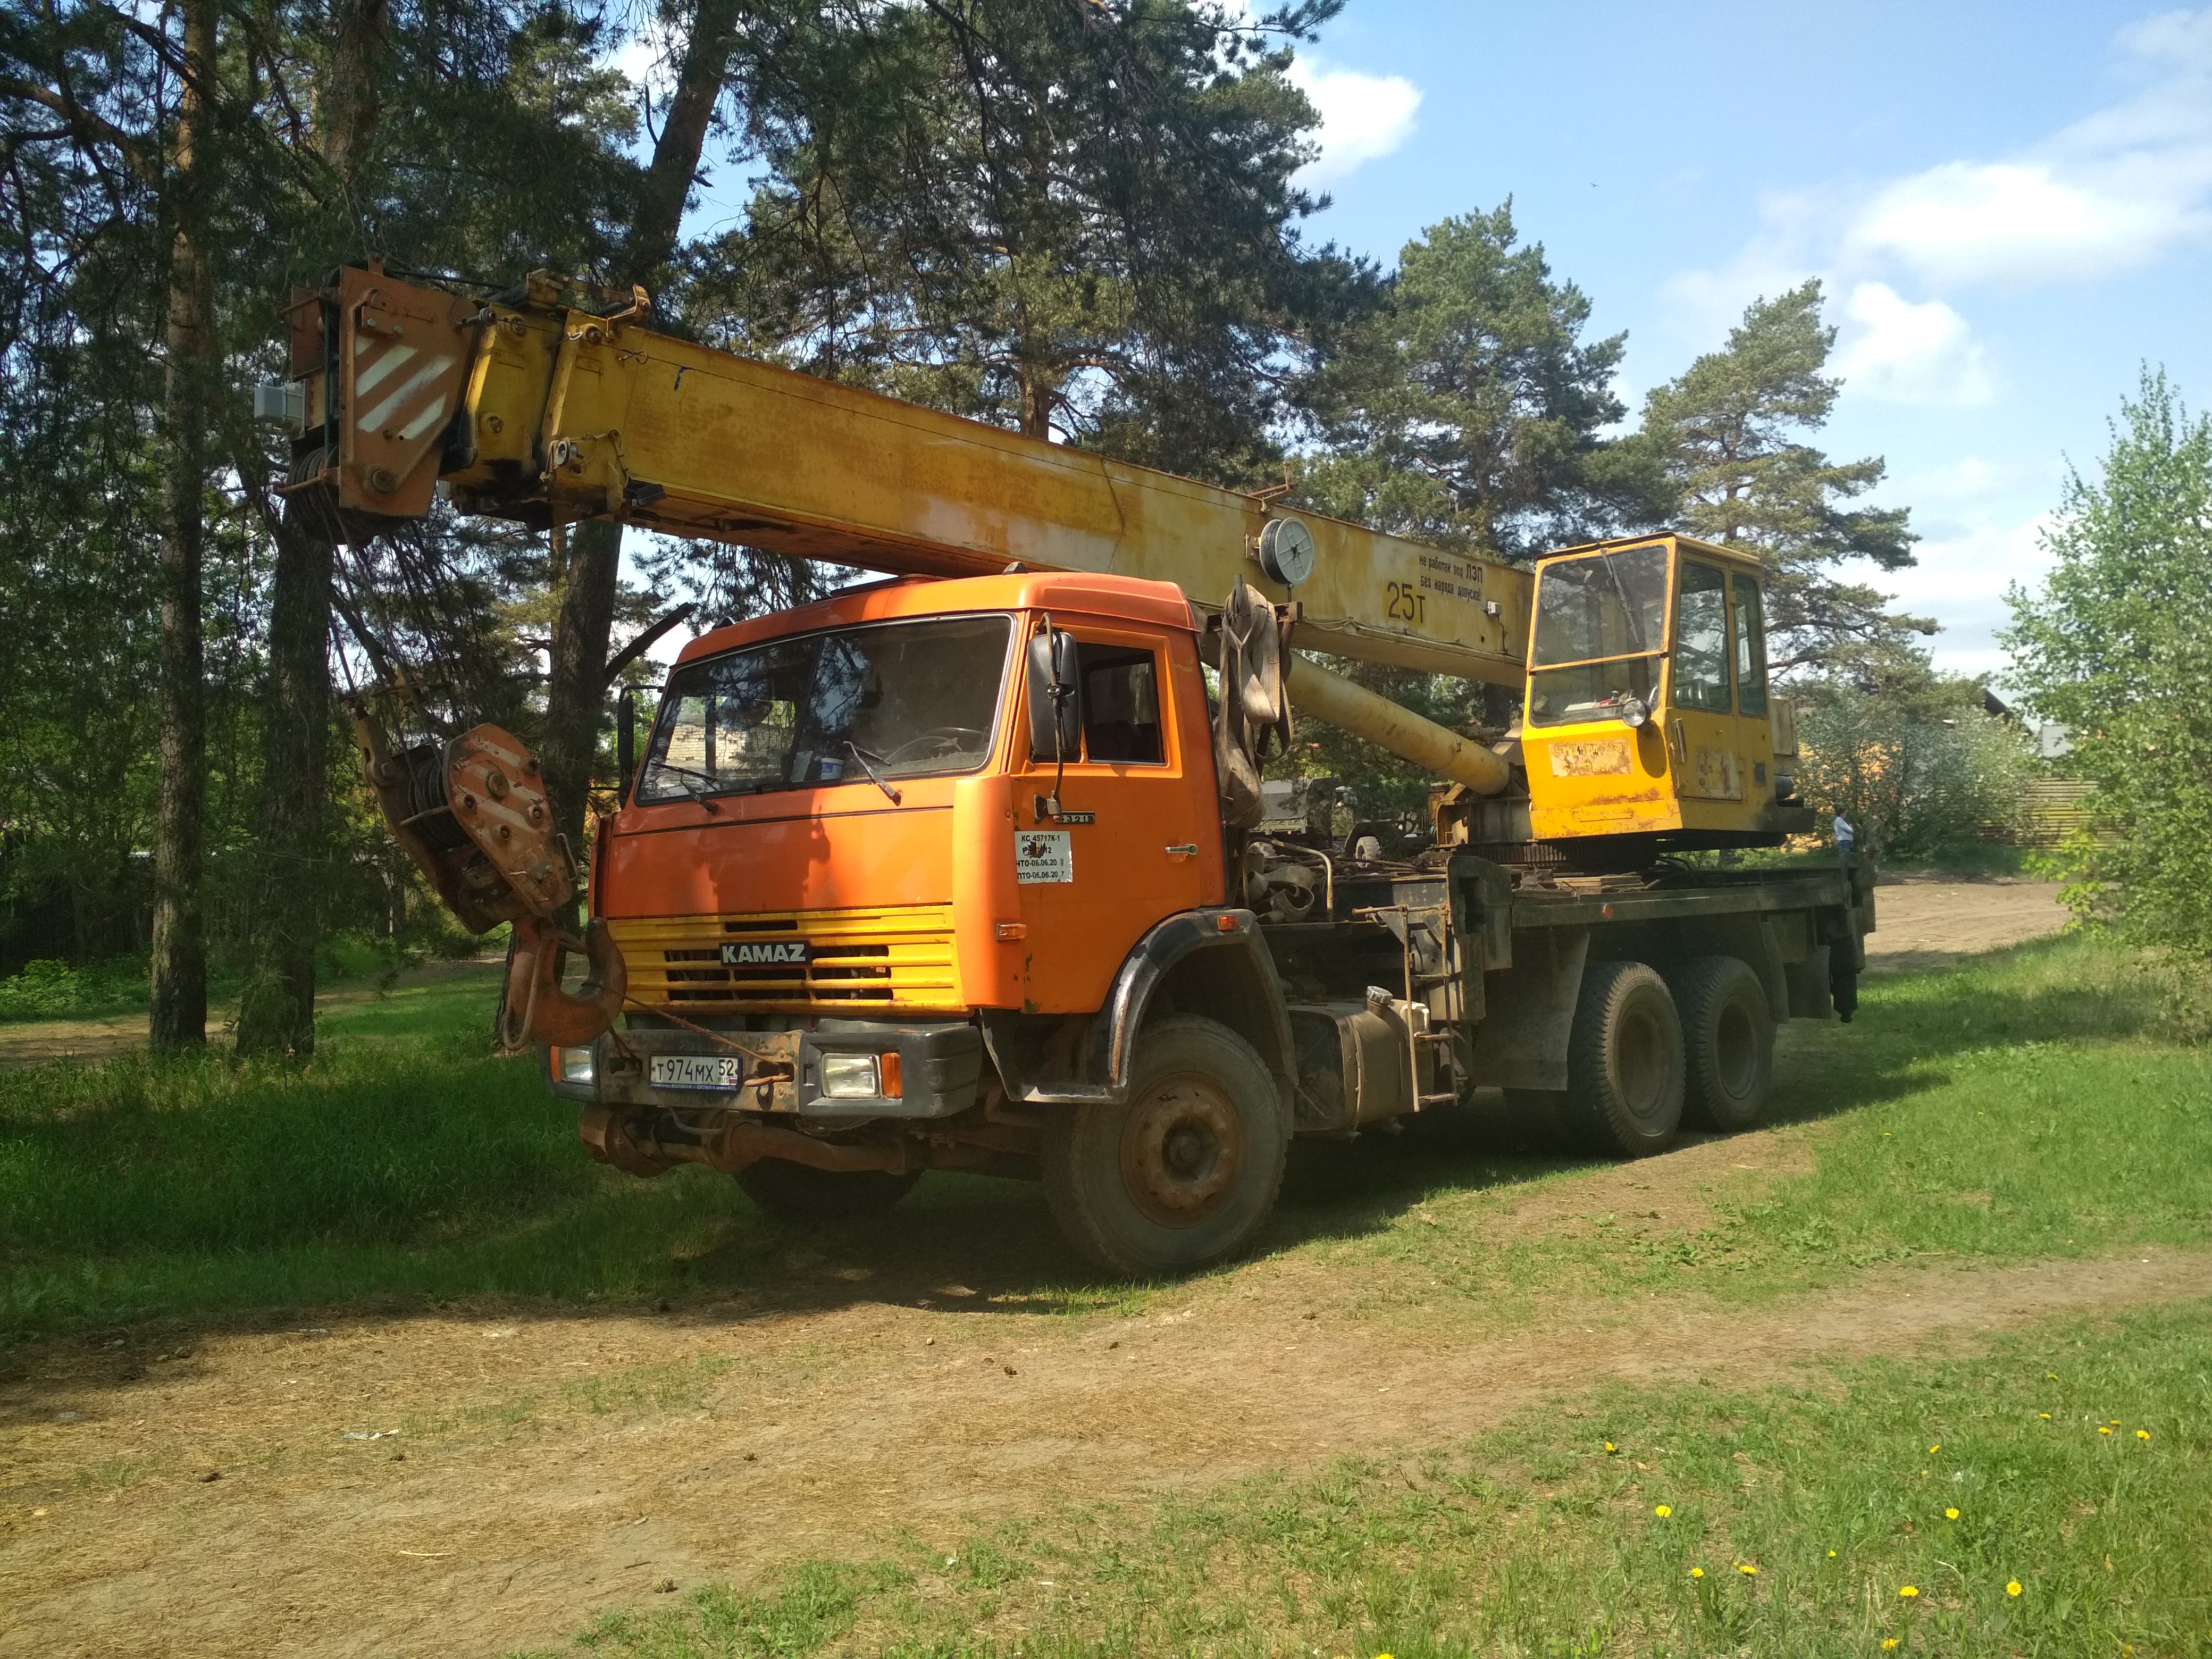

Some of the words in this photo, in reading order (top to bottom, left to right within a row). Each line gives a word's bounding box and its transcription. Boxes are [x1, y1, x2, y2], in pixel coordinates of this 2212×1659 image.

[1453, 565, 1463, 580] под
[1466, 564, 1483, 583] ЛЭП
[1434, 580, 1454, 596] наряда
[1457, 586, 1481, 602] допуска!
[722, 944, 806, 963] KAMAZ
[718, 1059, 734, 1076] 52
